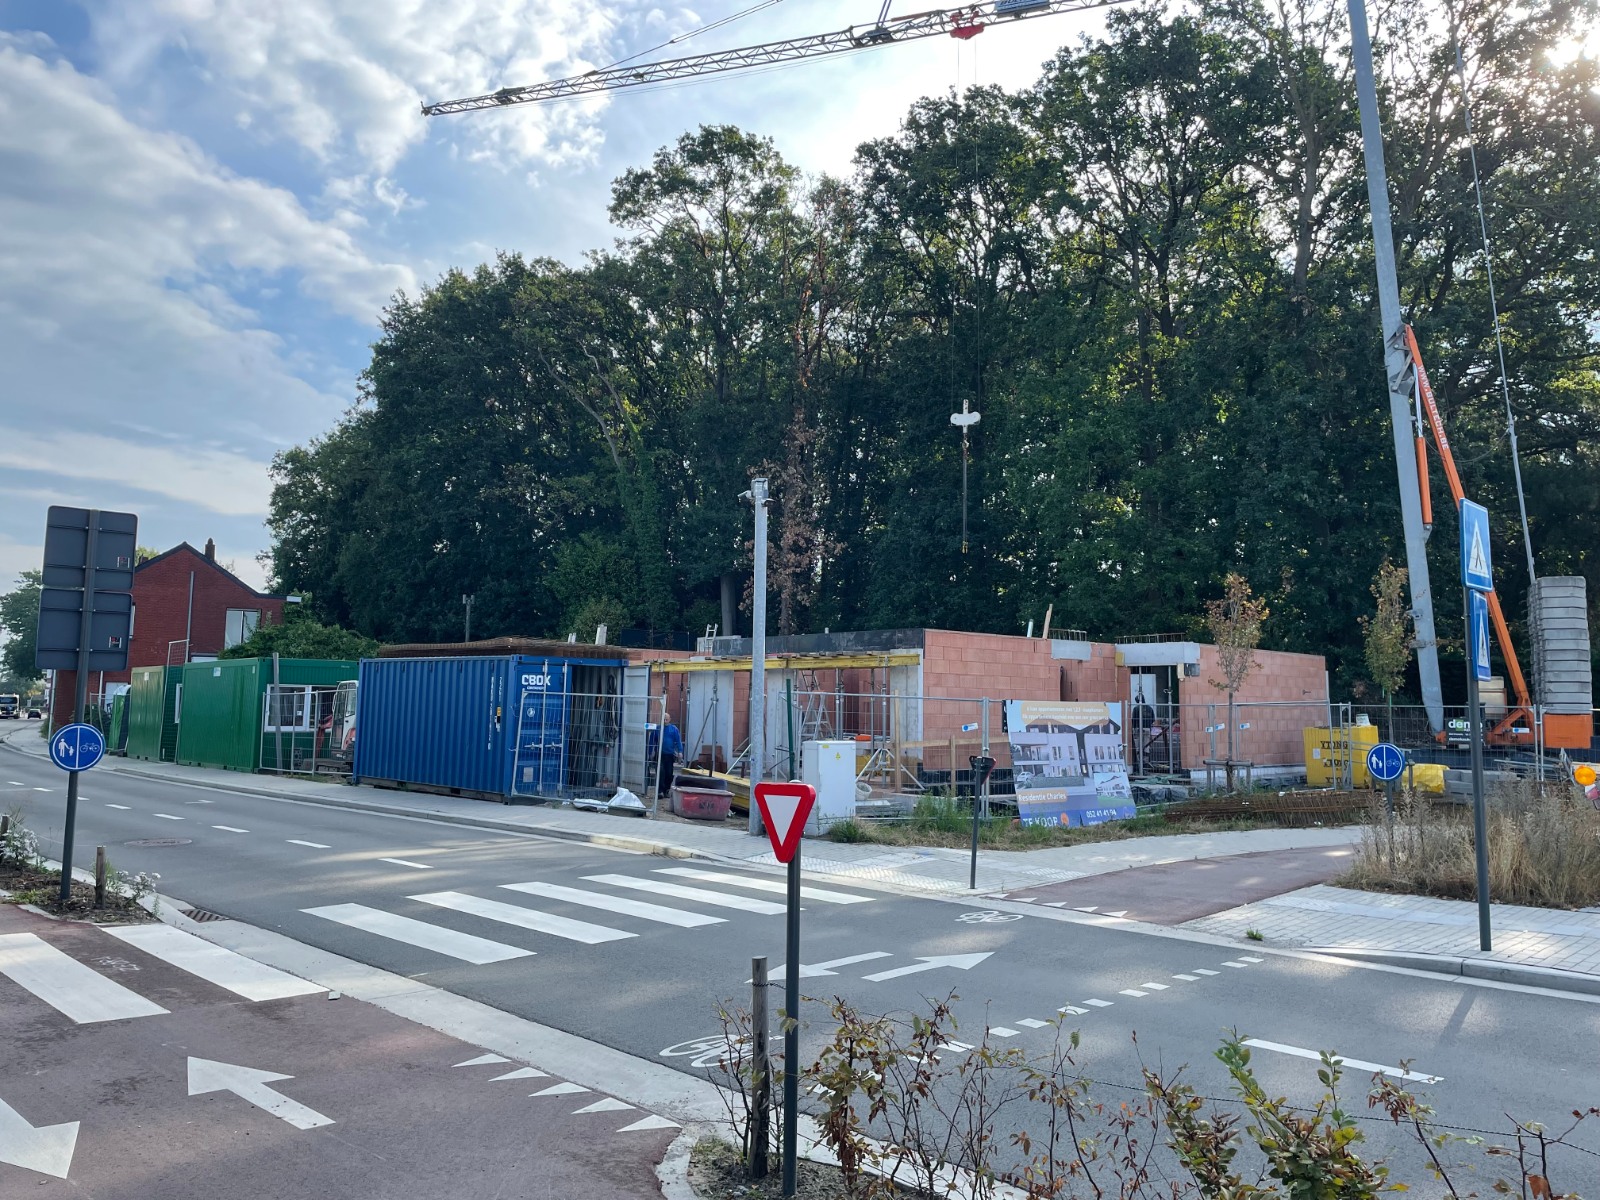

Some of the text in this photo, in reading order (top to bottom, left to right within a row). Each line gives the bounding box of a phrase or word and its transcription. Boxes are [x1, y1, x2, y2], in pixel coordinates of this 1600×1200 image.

[1417, 365, 1449, 450] WWW.BULTECH.BE
[1320, 741, 1348, 749] YTONG
[1018, 792, 1067, 802] Residentie Charles
